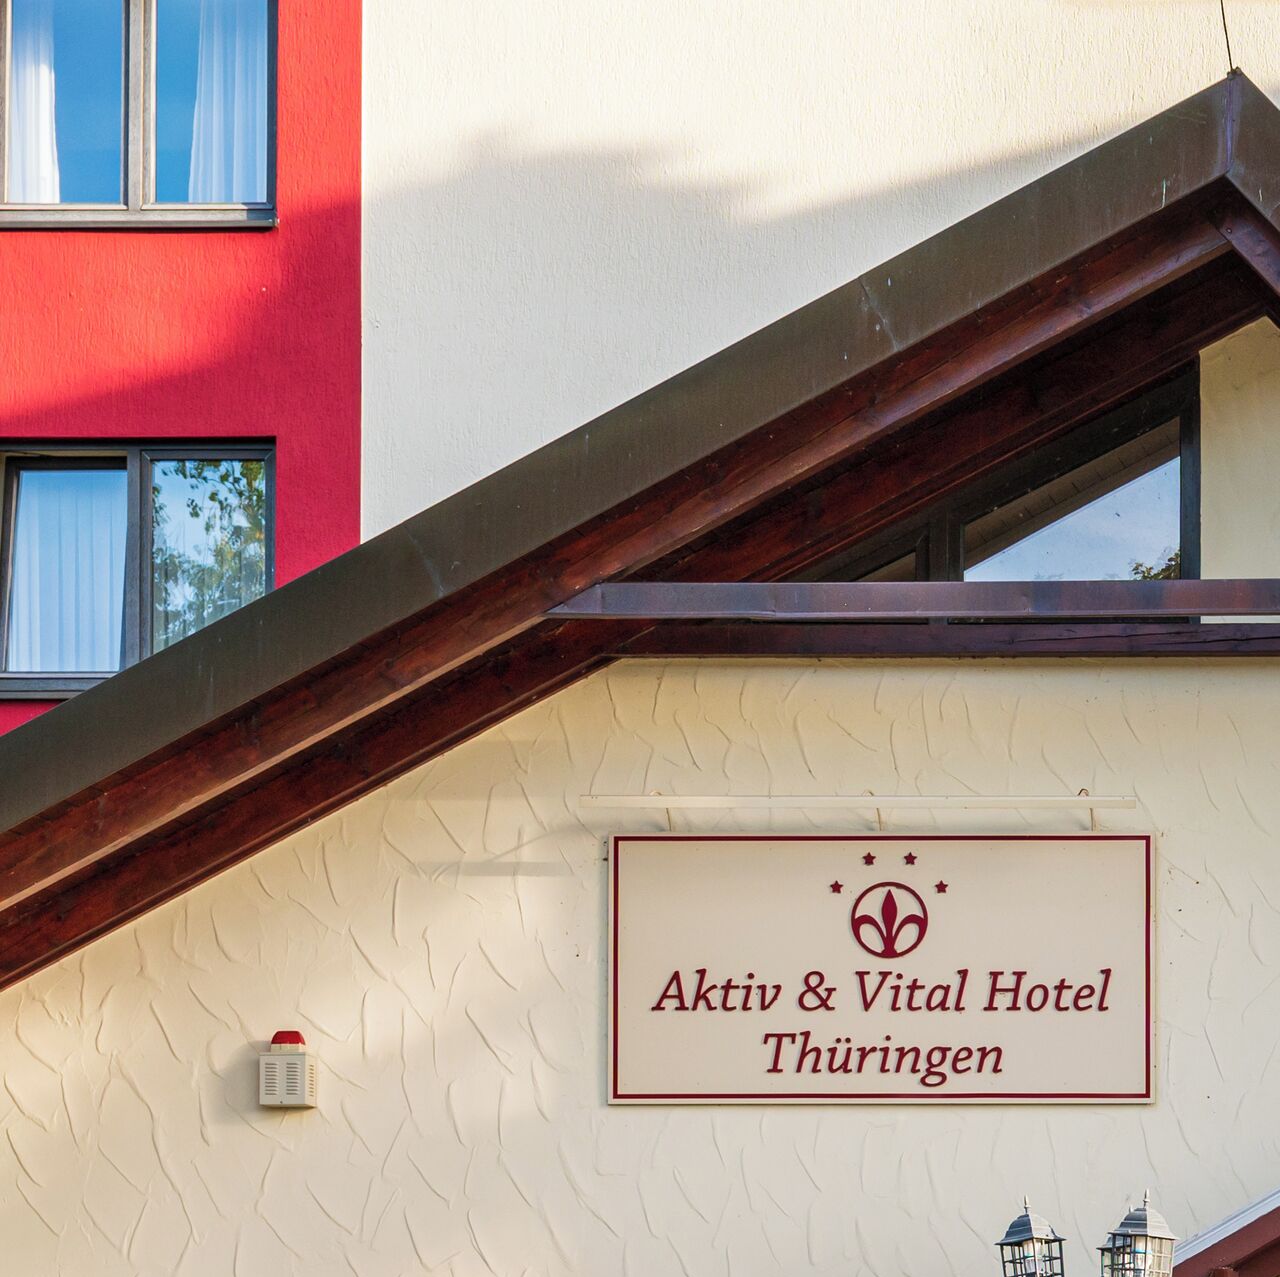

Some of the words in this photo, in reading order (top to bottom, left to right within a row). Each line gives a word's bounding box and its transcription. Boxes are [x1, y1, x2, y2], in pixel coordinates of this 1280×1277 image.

[651, 968, 782, 1012] Aktiv
[797, 970, 837, 1012] &
[855, 968, 969, 1013] Vital
[983, 967, 1112, 1012] Hotel
[763, 1031, 1003, 1087] Thüringen
